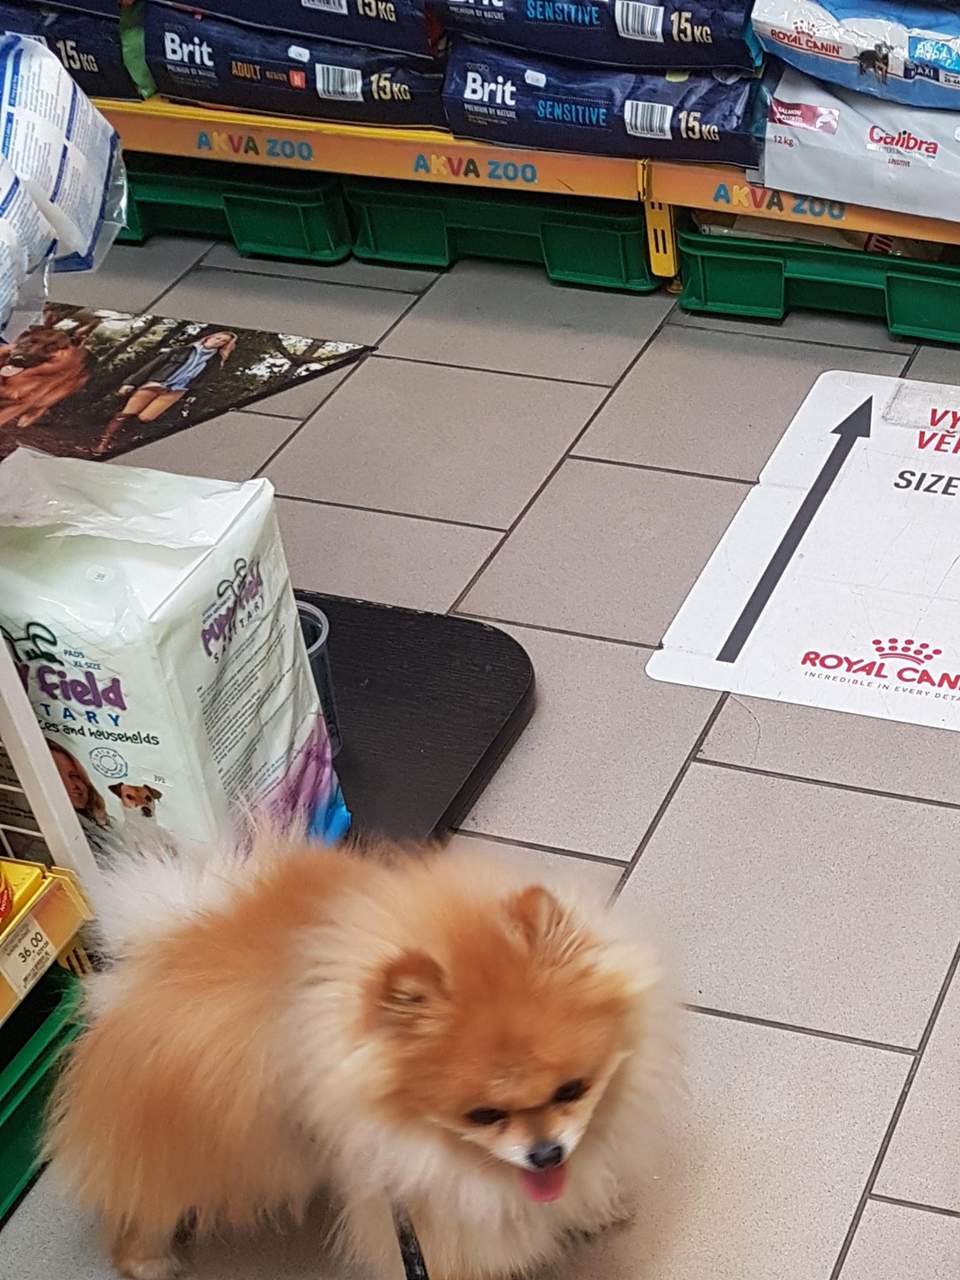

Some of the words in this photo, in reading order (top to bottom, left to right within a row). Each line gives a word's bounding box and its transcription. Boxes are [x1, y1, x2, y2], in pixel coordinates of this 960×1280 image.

[526, 0, 601, 25] SENSITIVE
[164, 32, 215, 67] Brit
[770, 29, 805, 46] ROYAL
[805, 40, 841, 55] CANIN
[231, 60, 262, 80] ADULT
[463, 71, 517, 106] Brit
[536, 100, 608, 127] SENSITIVE
[197, 130, 260, 156] AKVA
[265, 138, 314, 161] ZOO
[773, 135, 783, 144] 12
[869, 125, 939, 155] Calibra
[413, 153, 481, 180] AKVA
[487, 160, 538, 183] ZOO
[713, 183, 784, 212] AKVA
[791, 194, 846, 220] ZOO
[801, 650, 889, 679] ROYAL
[804, 671, 873, 688] INCREDIBLE
[894, 686, 930, 697] EVERY
[62, 725, 86, 737] and
[88, 727, 160, 746] households
